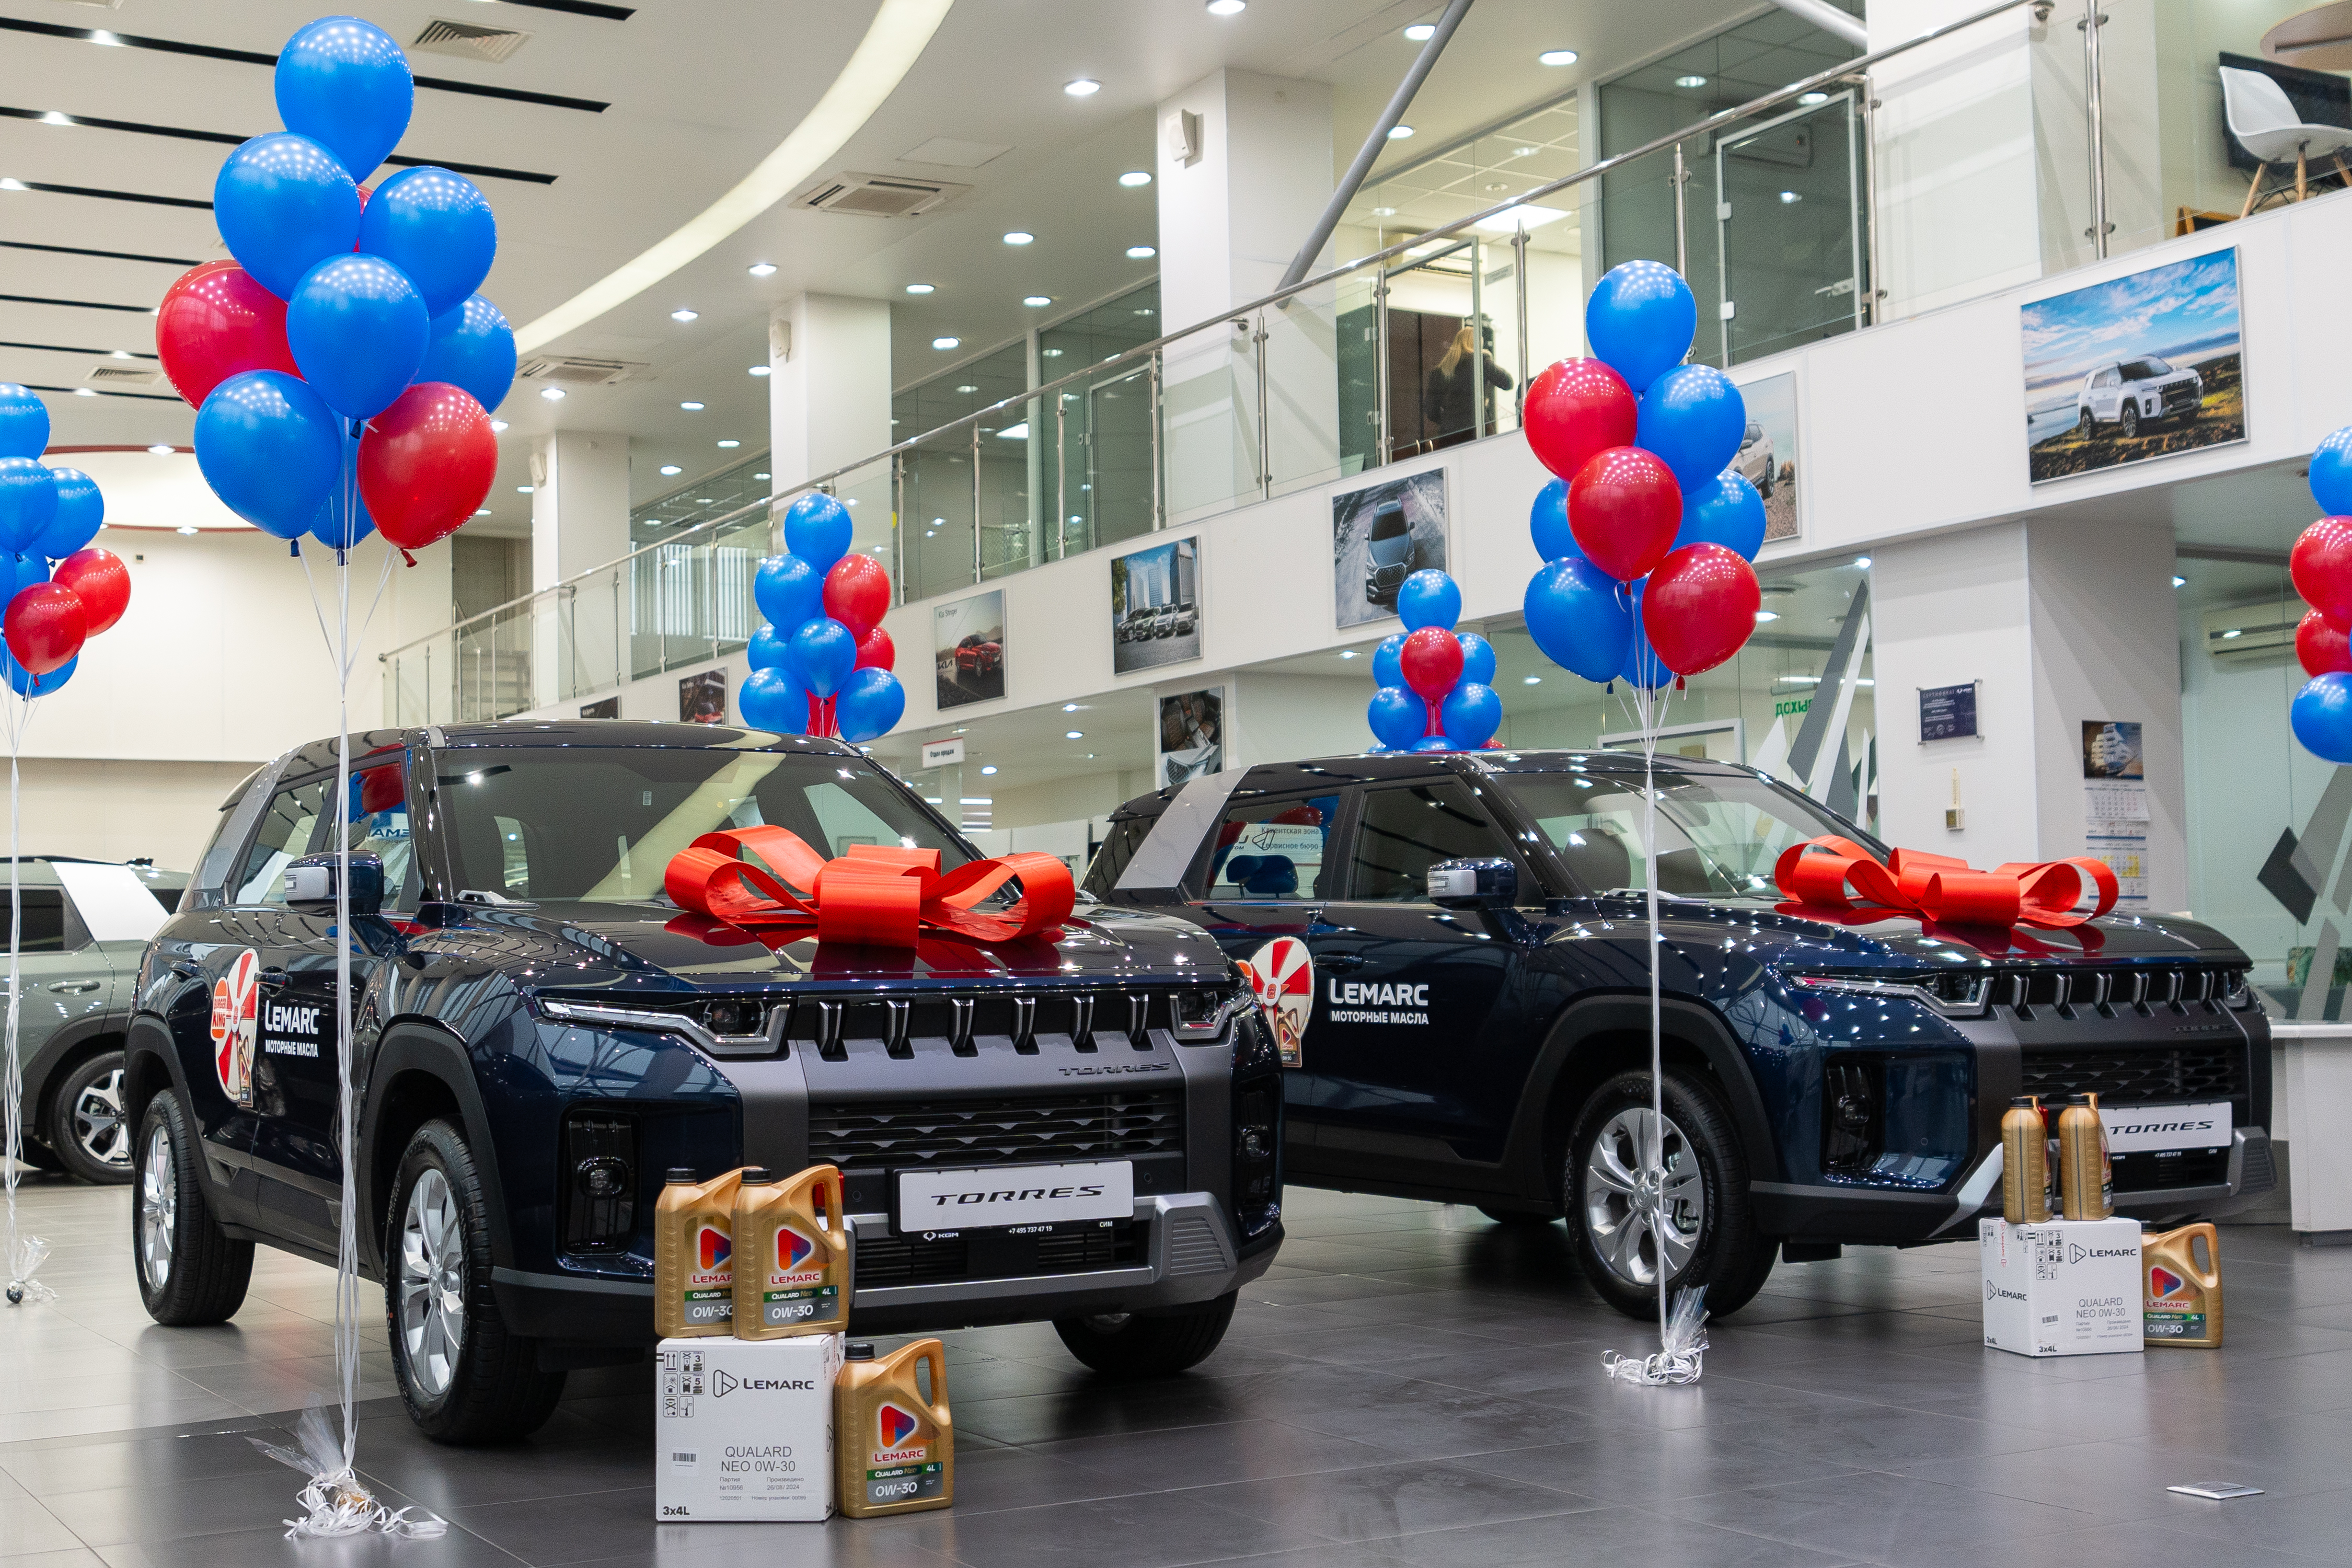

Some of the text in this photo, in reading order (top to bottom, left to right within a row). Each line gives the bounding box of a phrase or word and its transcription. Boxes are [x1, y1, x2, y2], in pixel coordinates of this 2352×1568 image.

[1300, 842, 1319, 850] бюро
[1330, 978, 1429, 1006] LEMARC
[265, 1000, 319, 1035] LEMARC
[1331, 1011, 1429, 1024] МОТОРНЫЕ МАСЛА
[266, 1040, 319, 1057] МОТОРНЫЕ МАСЛА
[1059, 1063, 1170, 1076] TORRES
[2109, 1121, 2214, 1135] TORRES
[931, 1185, 1105, 1206] TORRES
[2090, 1249, 2137, 1257] LEMARC
[771, 1273, 820, 1284] LEMARC
[1998, 1287, 2027, 1301] LEMARC
[2079, 1297, 2123, 1307] QUALARD
[2077, 1308, 2126, 1318] NEO 0W-30
[743, 1378, 815, 1391] LEMARC
[725, 1446, 792, 1458] QUALARD
[874, 1449, 924, 1462] LEMARC
[721, 1461, 795, 1472] NEO 0W-30
[875, 1469, 903, 1478] QUALARD
[663, 1506, 690, 1516] 3x4L
